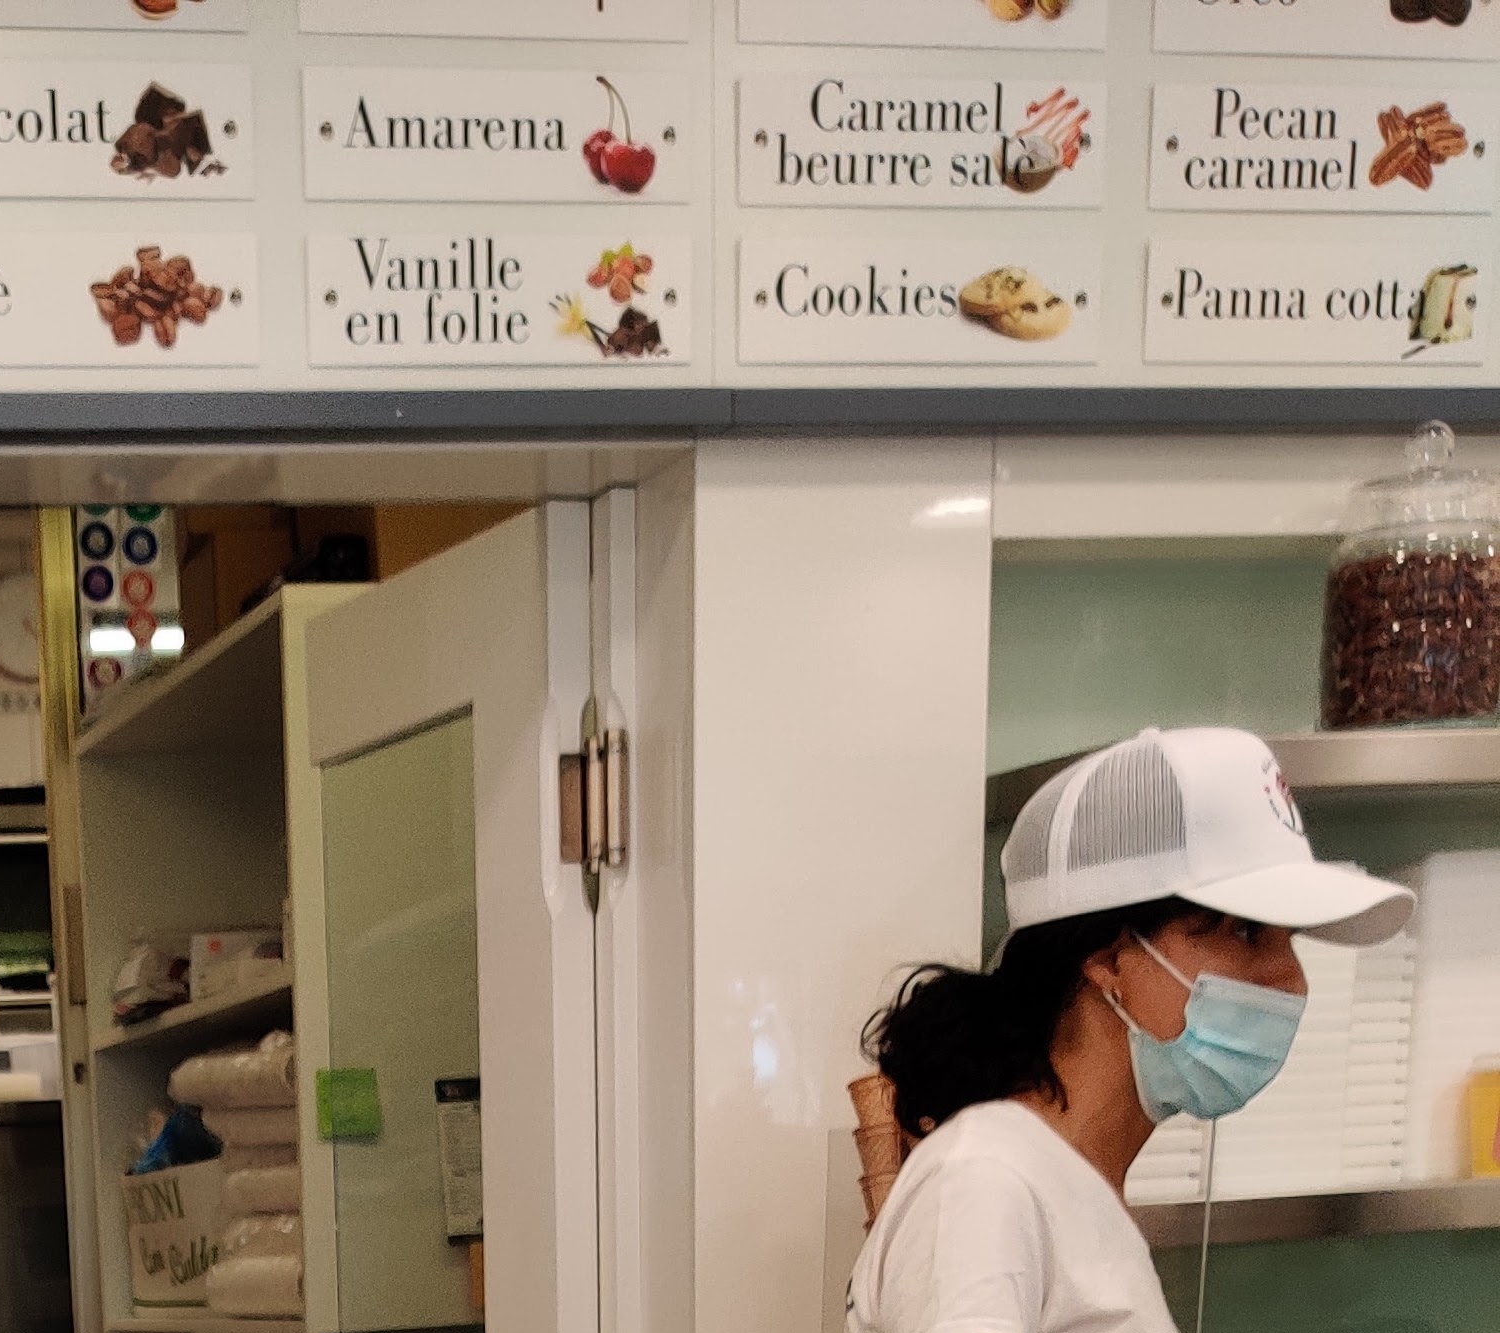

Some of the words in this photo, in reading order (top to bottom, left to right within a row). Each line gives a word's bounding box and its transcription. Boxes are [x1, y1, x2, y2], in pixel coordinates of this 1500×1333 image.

[343, 95, 568, 152] Amarena
[809, 78, 1004, 135] Caramel
[1211, 87, 1339, 141] Pecan
[775, 133, 933, 188] beurre
[1184, 140, 1360, 193] caramel
[350, 236, 524, 292] Vanille
[774, 262, 961, 320] Cookies
[345, 311, 404, 346] en
[424, 292, 531, 346] folie
[1175, 267, 1308, 321] Panna
